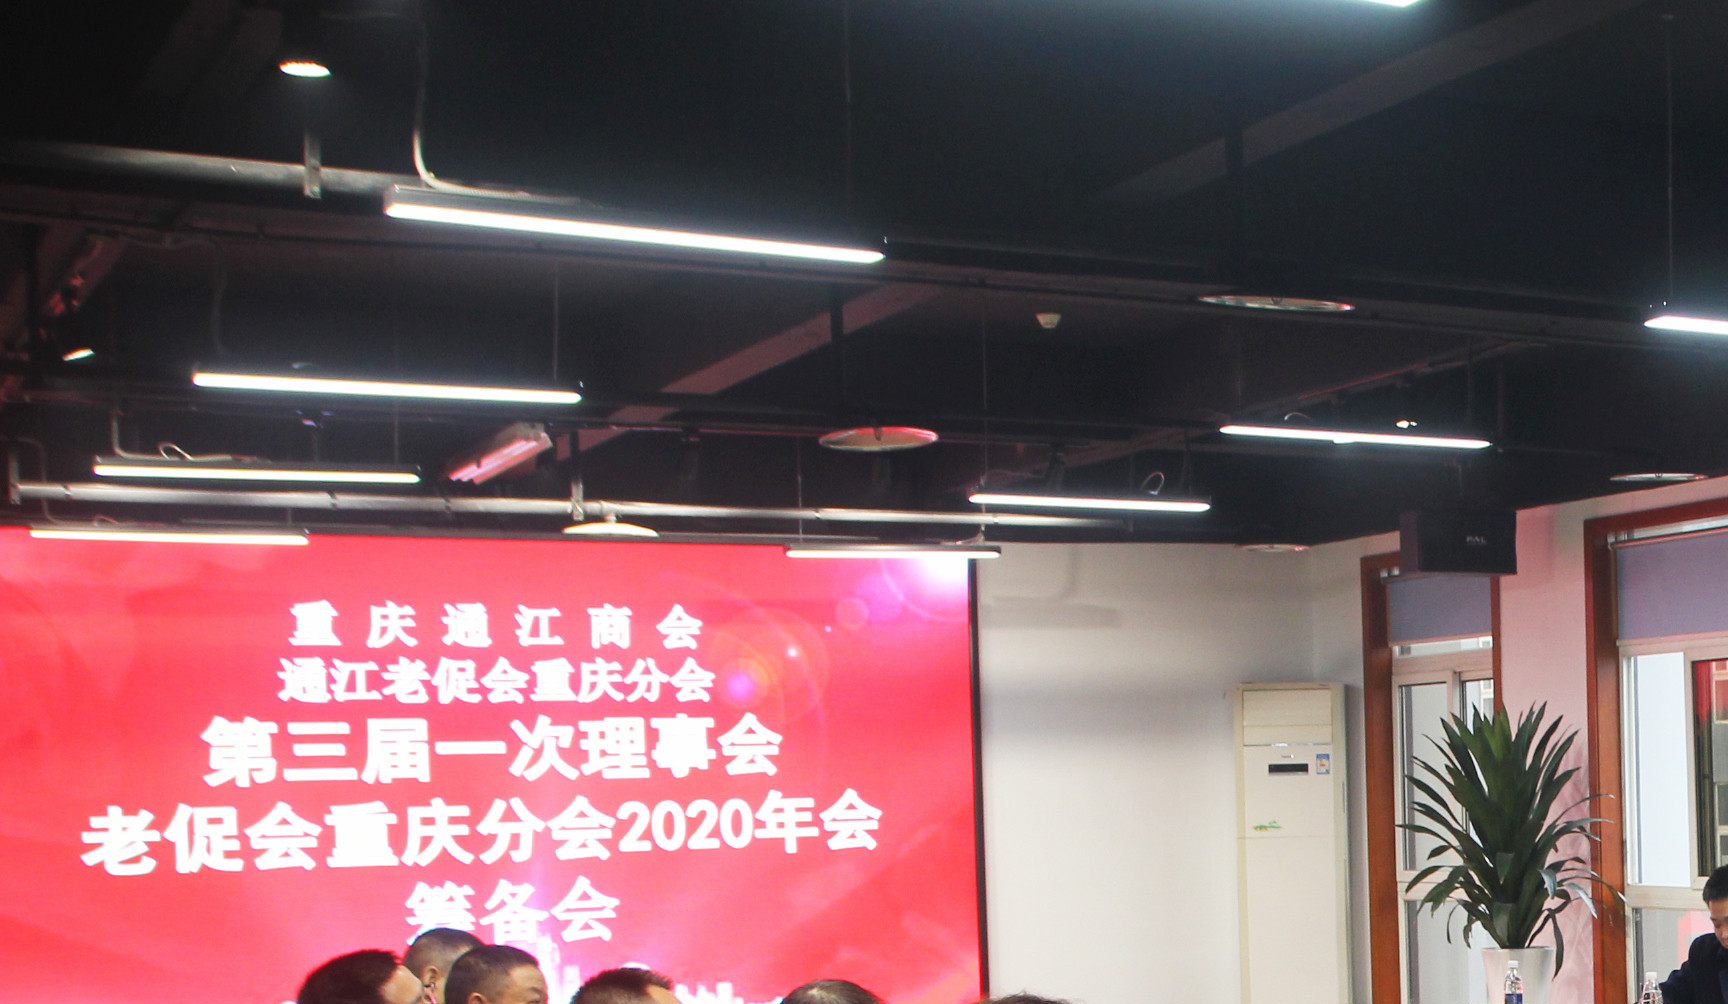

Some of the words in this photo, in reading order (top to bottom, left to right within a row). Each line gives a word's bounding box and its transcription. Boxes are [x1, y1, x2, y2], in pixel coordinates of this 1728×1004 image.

[288, 599, 703, 649] 重庆通江商会
[276, 655, 716, 704] 通江老促会重庆分会
[200, 712, 783, 788] 第三届一次理事会
[80, 788, 883, 876] 老促会重庆分会2020年会
[404, 875, 620, 946] 筹备会
